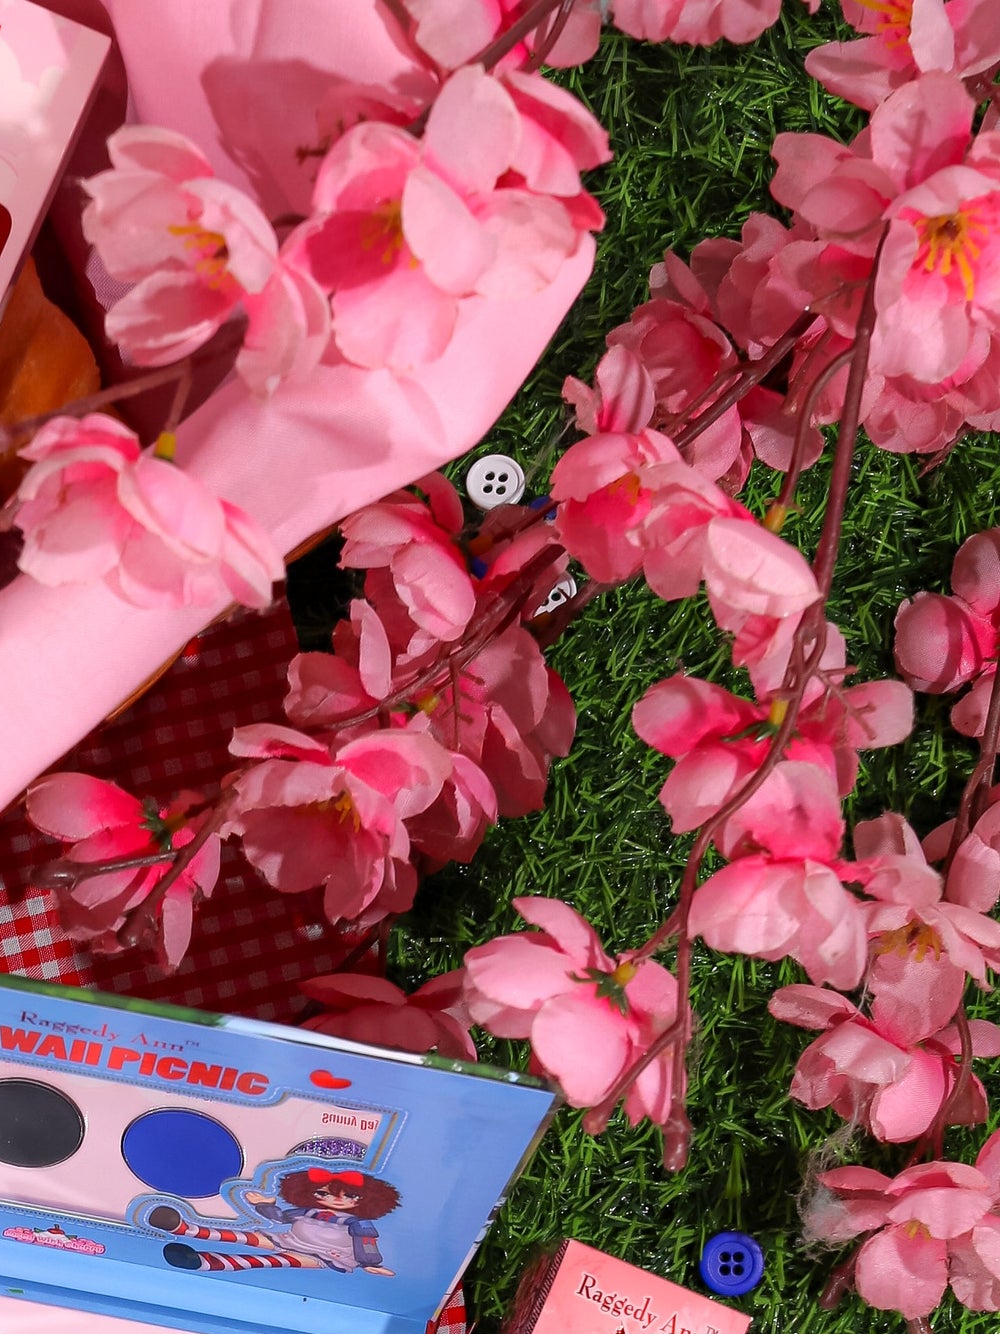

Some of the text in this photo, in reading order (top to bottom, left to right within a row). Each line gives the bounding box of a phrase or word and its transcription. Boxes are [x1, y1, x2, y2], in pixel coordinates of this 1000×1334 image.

[20, 1011, 120, 1041] Raggedy
[107, 1046, 270, 1095] PICNIC
[576, 1274, 656, 1328] Raggedy
